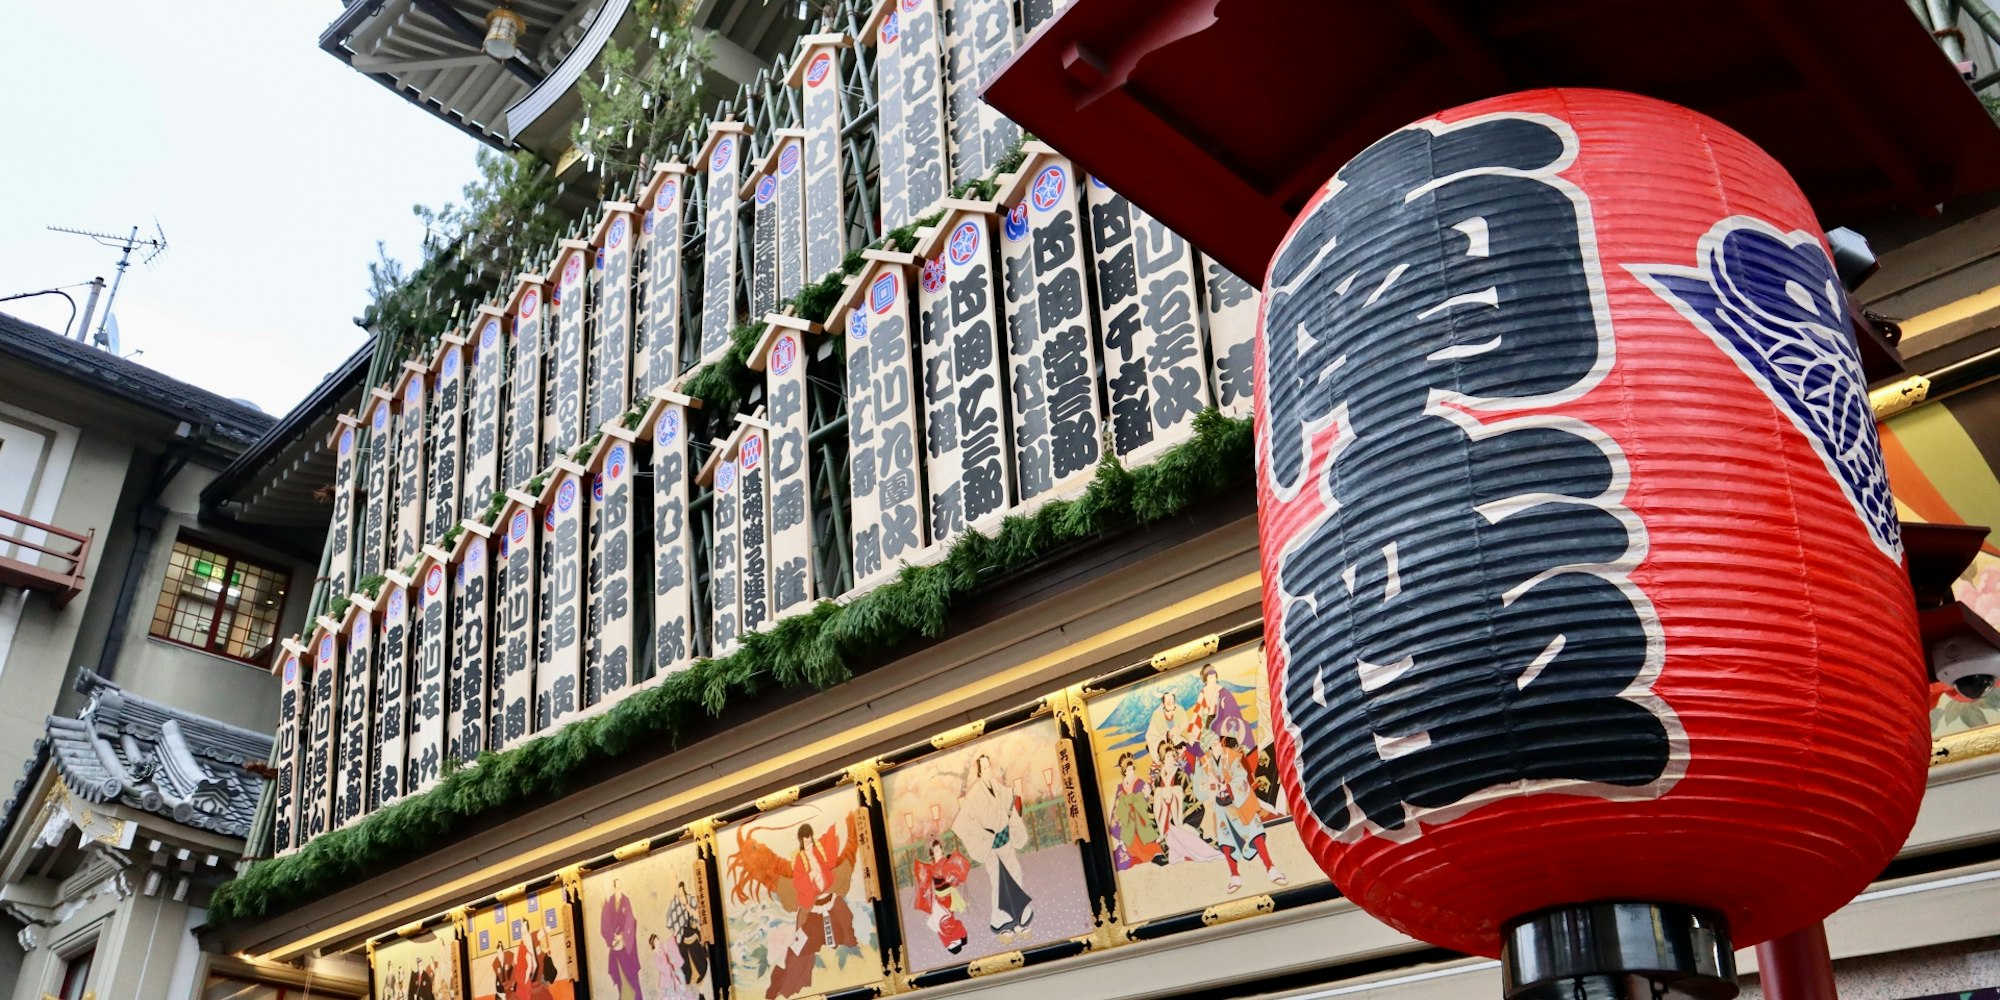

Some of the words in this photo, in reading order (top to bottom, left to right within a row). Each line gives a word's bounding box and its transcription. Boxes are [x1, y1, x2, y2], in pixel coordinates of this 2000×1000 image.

[715, 493, 736, 650] 竹本連中
[1265, 112, 1682, 836] 南座
